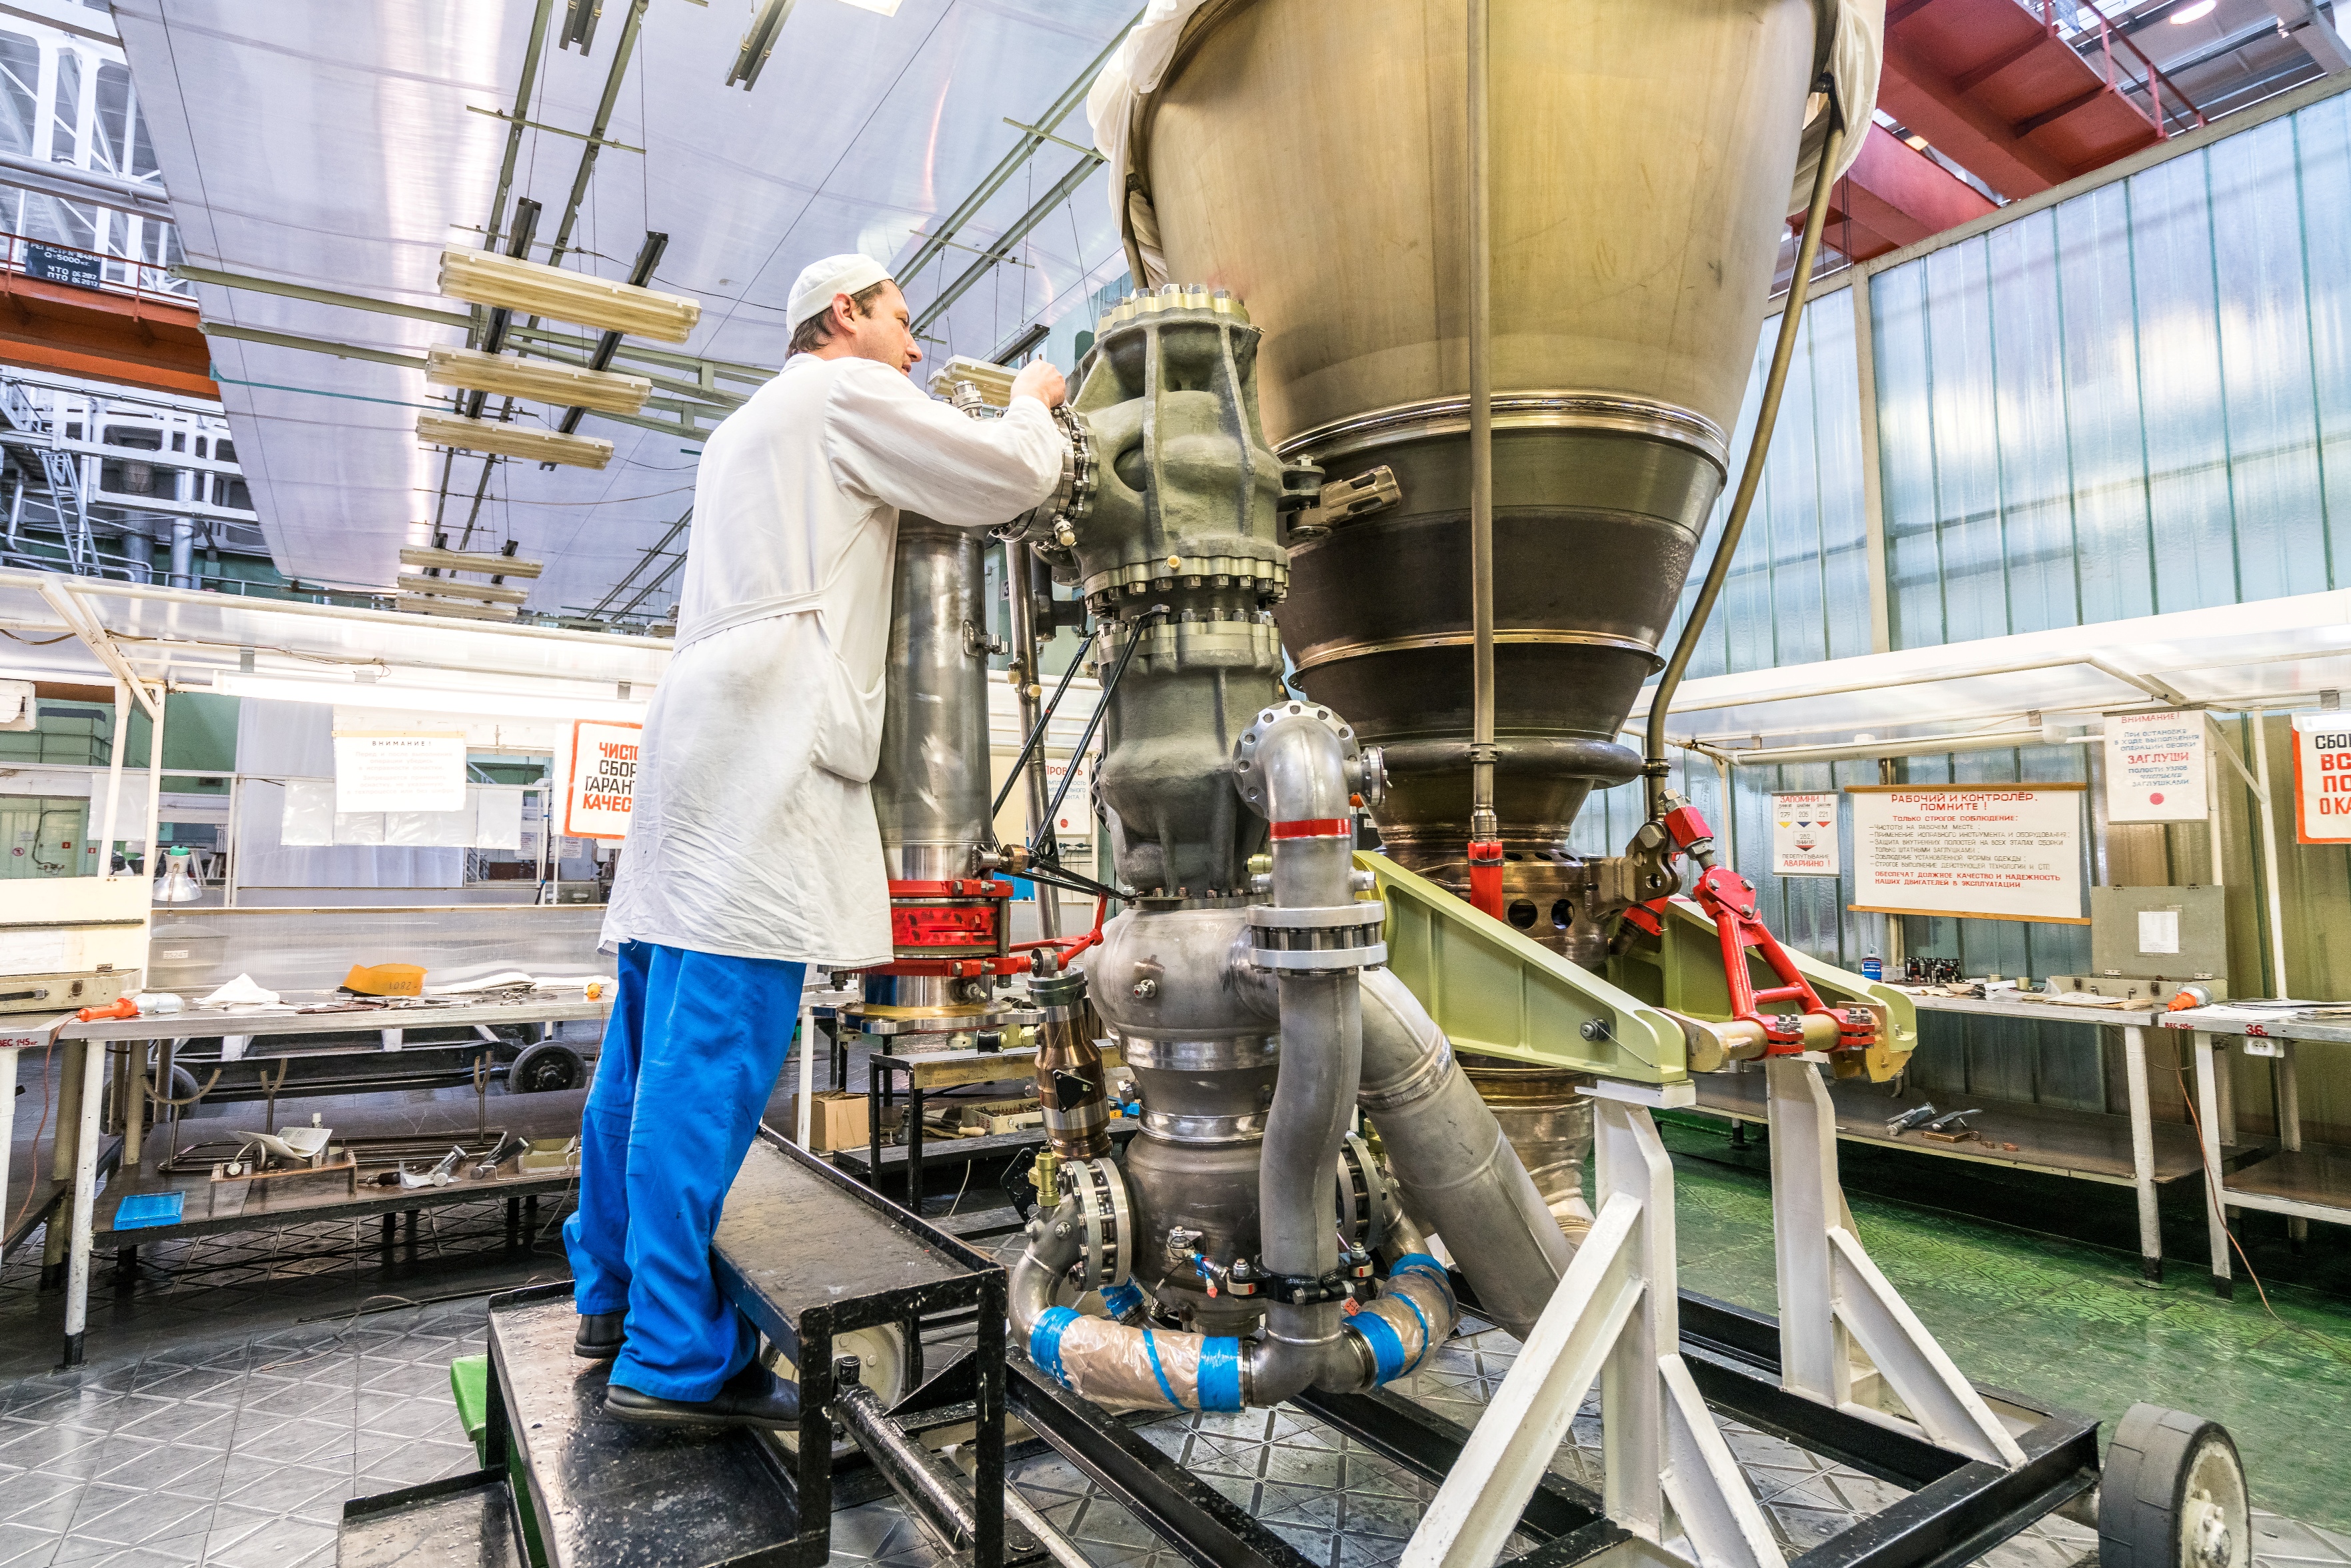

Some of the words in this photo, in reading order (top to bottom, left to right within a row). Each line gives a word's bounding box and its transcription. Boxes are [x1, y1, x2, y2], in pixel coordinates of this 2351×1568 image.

[47, 265, 69, 275] ЧТО
[47, 271, 68, 281] ПТО
[2316, 734, 2351, 749] СБО
[2128, 752, 2189, 764] ЗАГЛУШИ
[1046, 766, 1083, 776] ПРОВЬ
[585, 776, 634, 795] ГАРАН
[1892, 793, 1945, 802] РАБОЧИЙ
[2320, 798, 2331, 814] О
